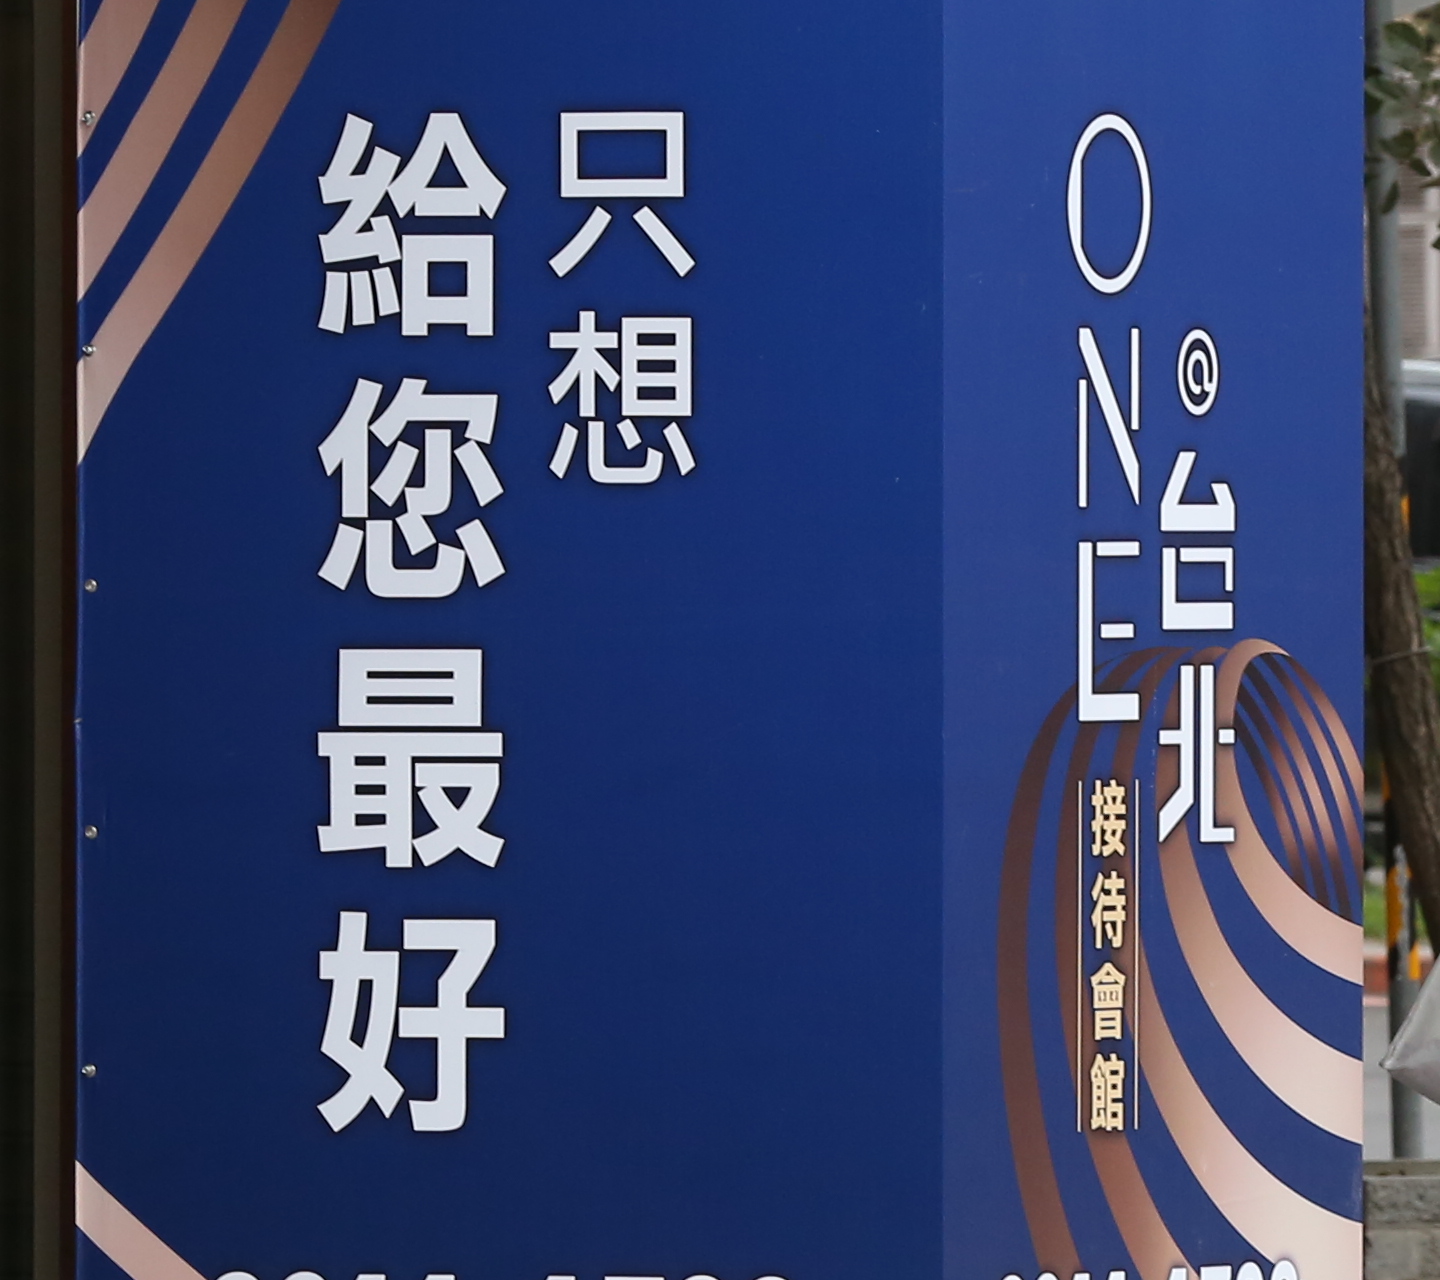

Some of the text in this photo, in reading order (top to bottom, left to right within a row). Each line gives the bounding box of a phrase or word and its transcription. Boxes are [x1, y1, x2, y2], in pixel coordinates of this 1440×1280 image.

[547, 110, 696, 485] 只想
[1066, 112, 1152, 722] ONE
[316, 111, 508, 1133] 給您最好
[1089, 778, 1128, 1132] 接待會館
